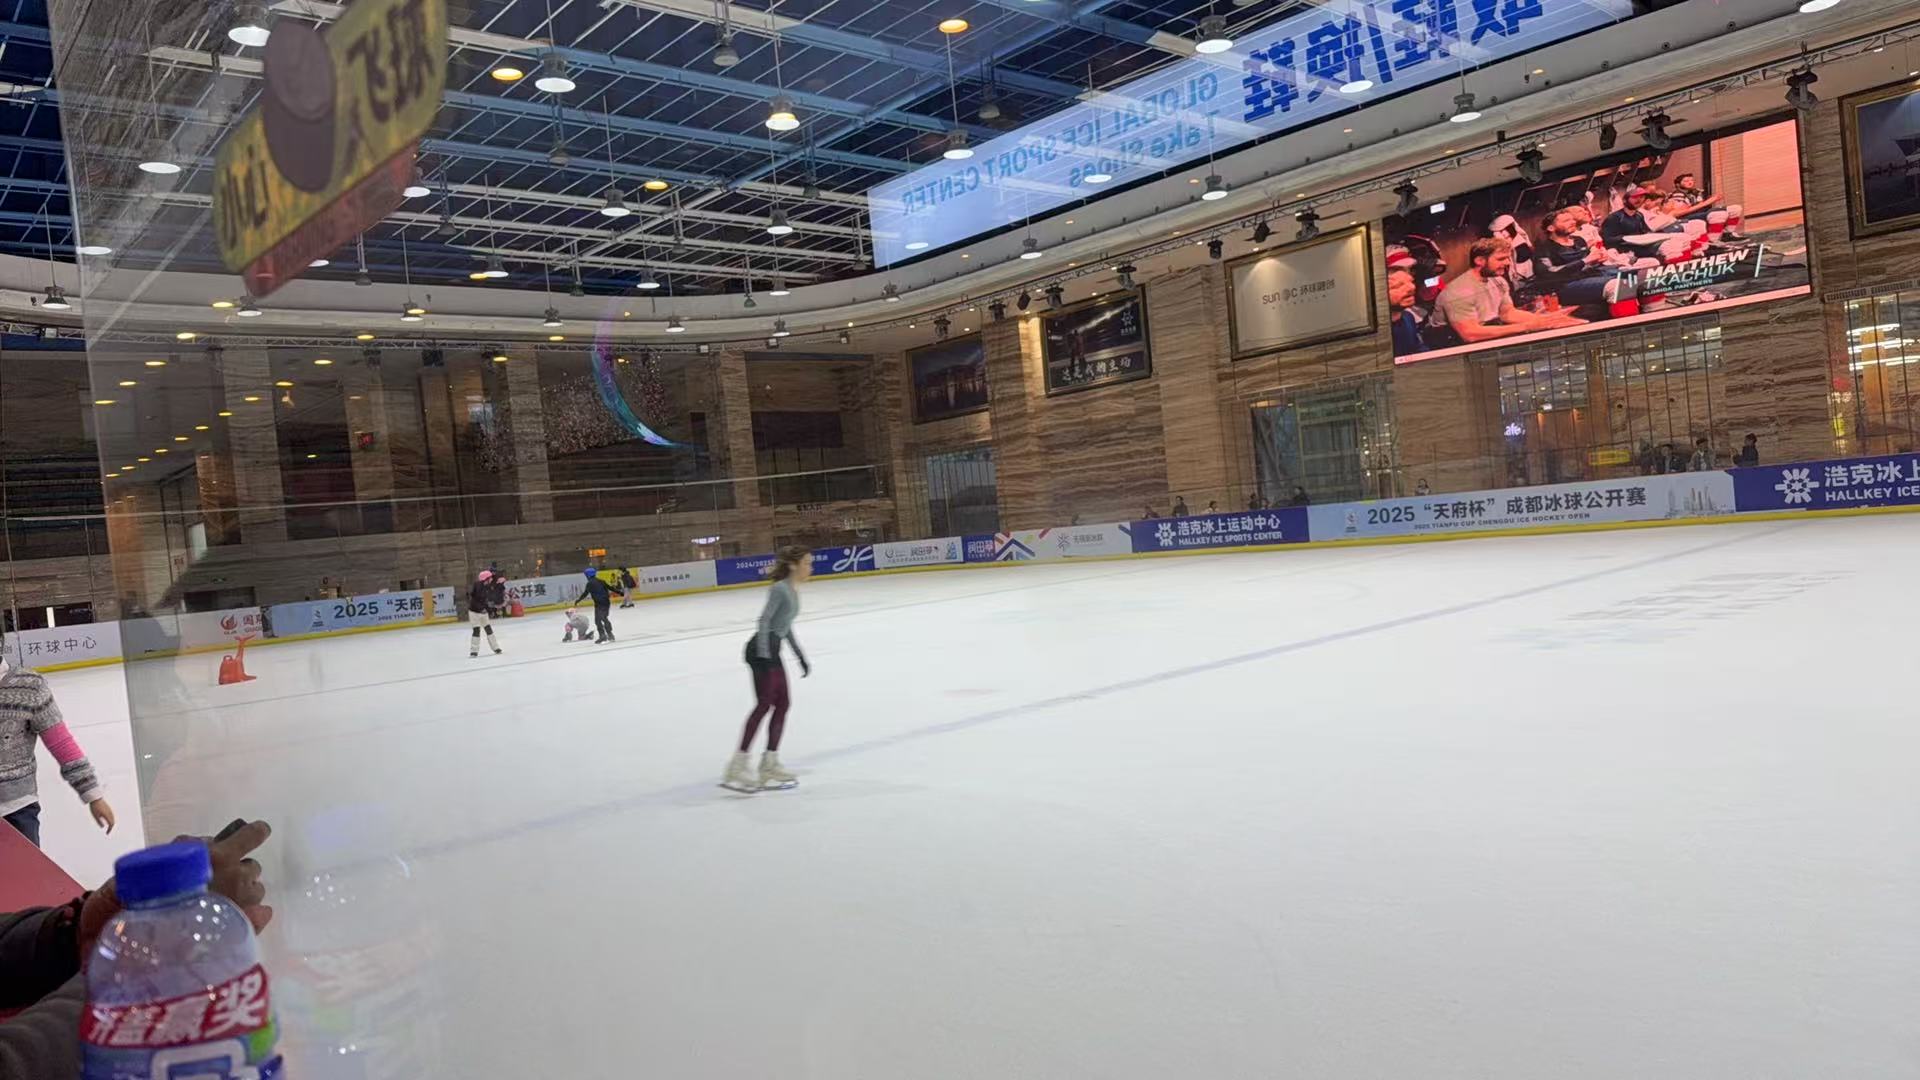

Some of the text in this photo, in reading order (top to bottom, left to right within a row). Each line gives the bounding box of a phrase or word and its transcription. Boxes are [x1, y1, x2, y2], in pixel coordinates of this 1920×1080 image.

[1646, 248, 1750, 279] MATTHEW
[1645, 262, 1736, 290] TKACHUK
[1824, 459, 1920, 487] 浩克冰上
[1825, 485, 1920, 502] HALLKEY ICE
[1177, 513, 1281, 536] 浩克冰上运动中心
[1224, 532, 1253, 543] SPORTS
[1253, 530, 1283, 541] CENTER
[27, 636, 97, 656] 环球中心
